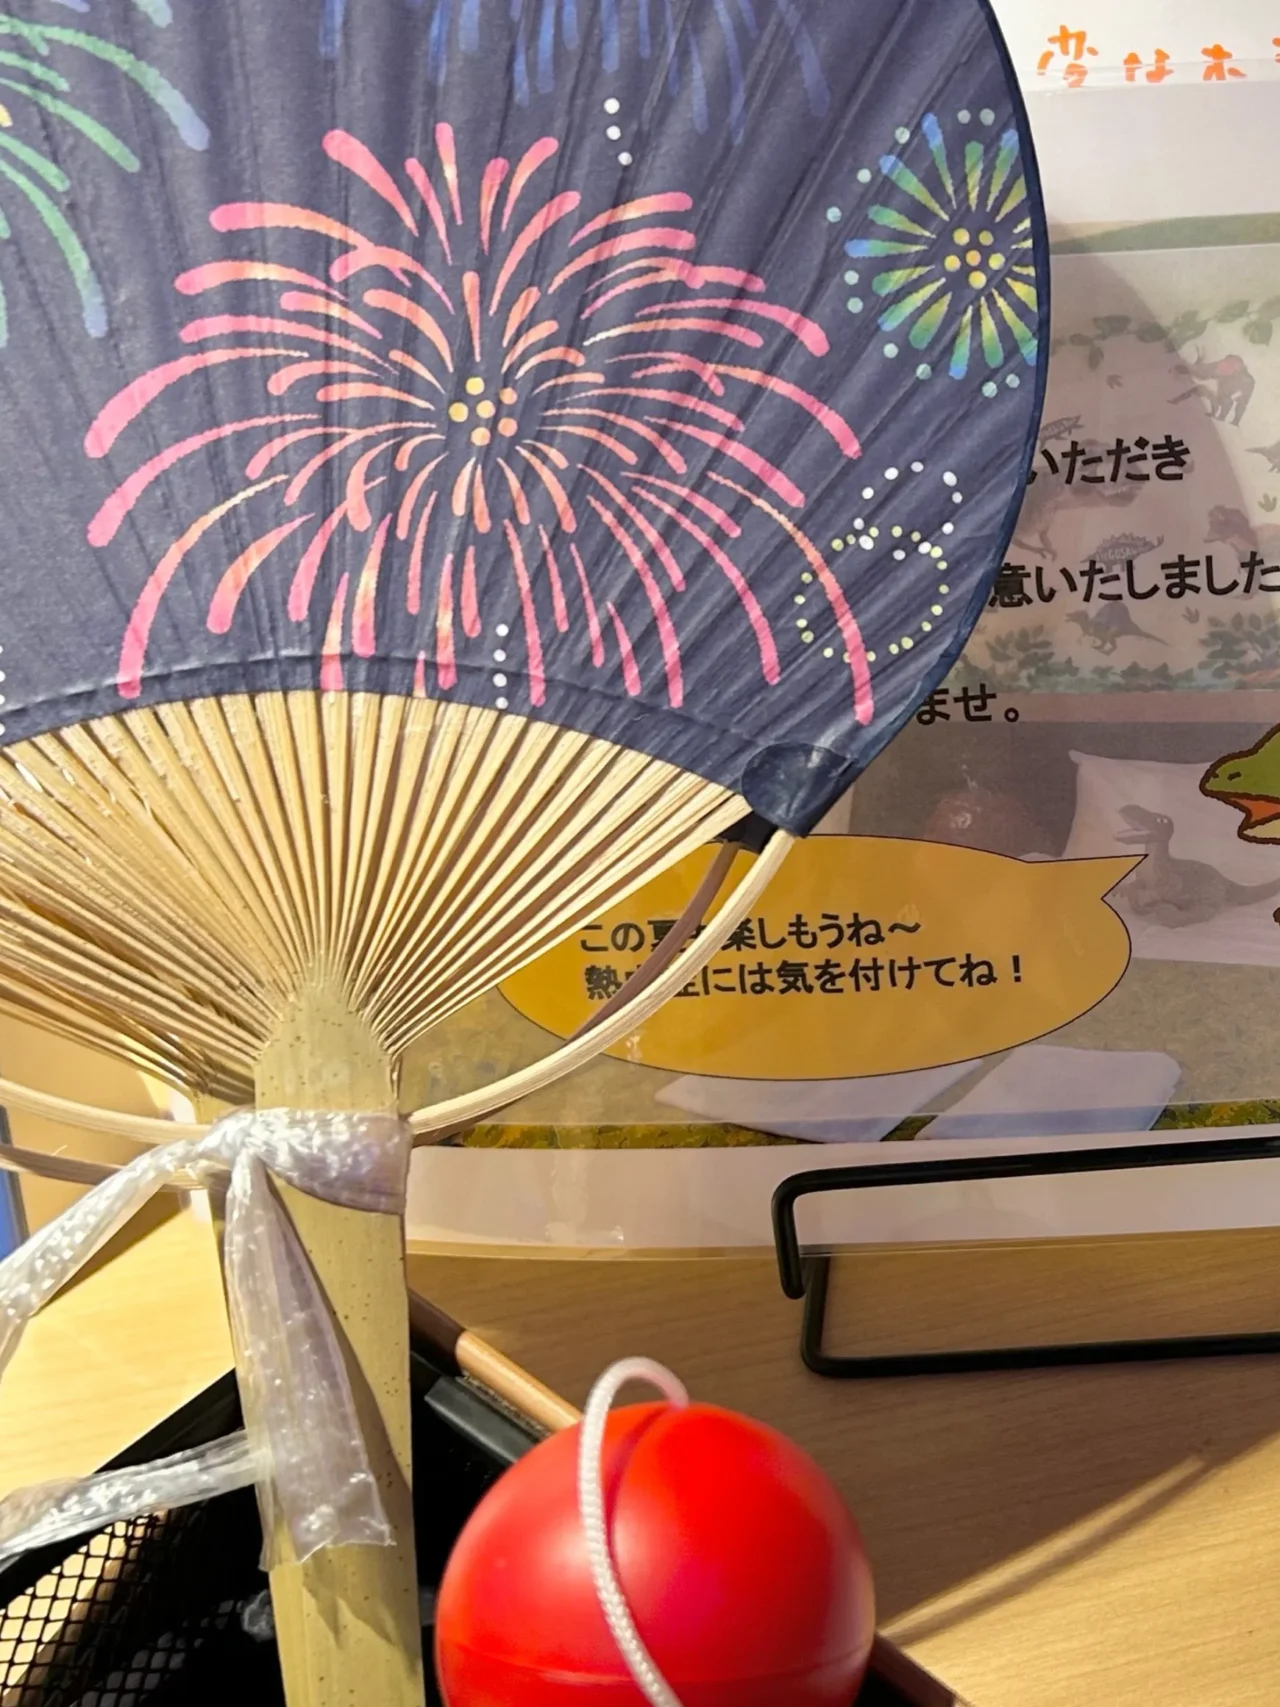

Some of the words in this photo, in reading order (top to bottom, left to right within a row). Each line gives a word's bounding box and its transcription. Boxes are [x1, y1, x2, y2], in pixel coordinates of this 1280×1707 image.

[584, 955, 1023, 1001] 熱には気を付けてね！
